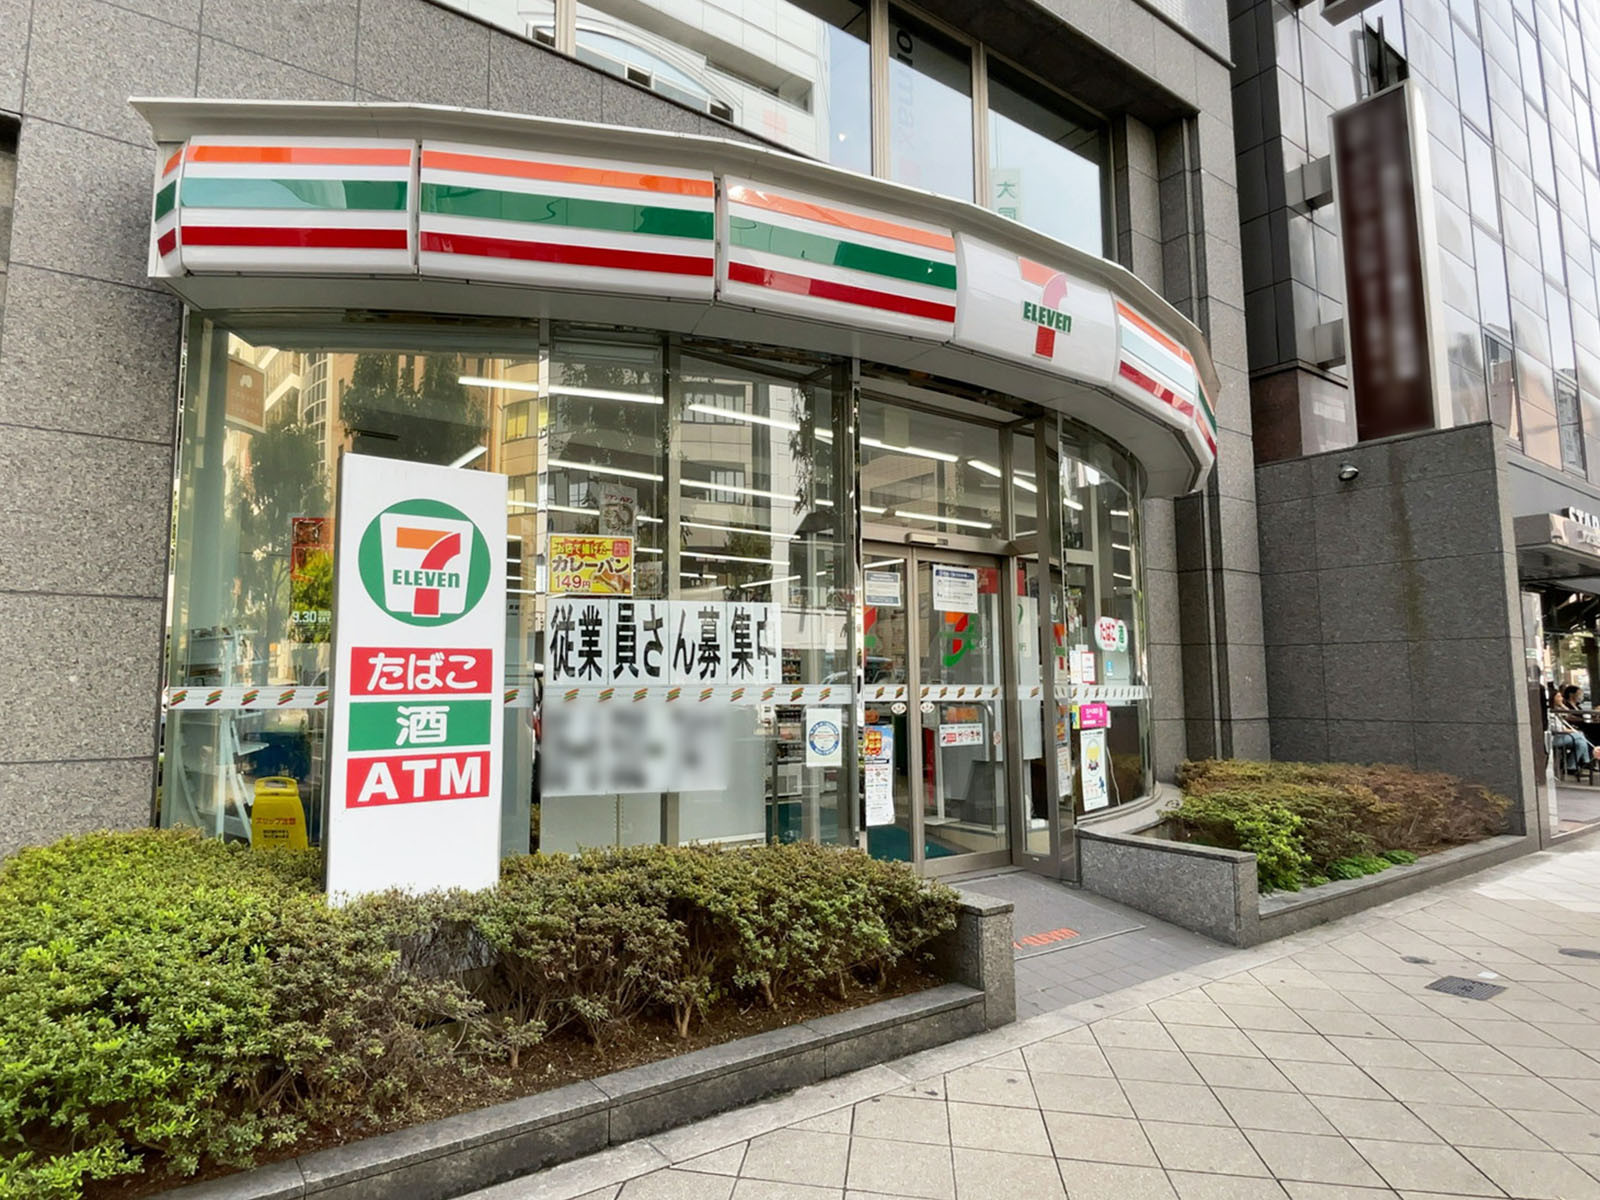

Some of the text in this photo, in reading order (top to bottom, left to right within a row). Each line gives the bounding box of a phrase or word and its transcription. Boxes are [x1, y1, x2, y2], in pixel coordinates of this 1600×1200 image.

[1018, 257, 1068, 358] 7
[1023, 300, 1072, 333] ELEVEN
[392, 569, 460, 588] ELEVEN
[396, 526, 461, 616] 7
[551, 555, 630, 573] カレーパン
[367, 652, 478, 691] たばこ
[395, 705, 450, 746] 酒
[357, 756, 482, 803] ATM
